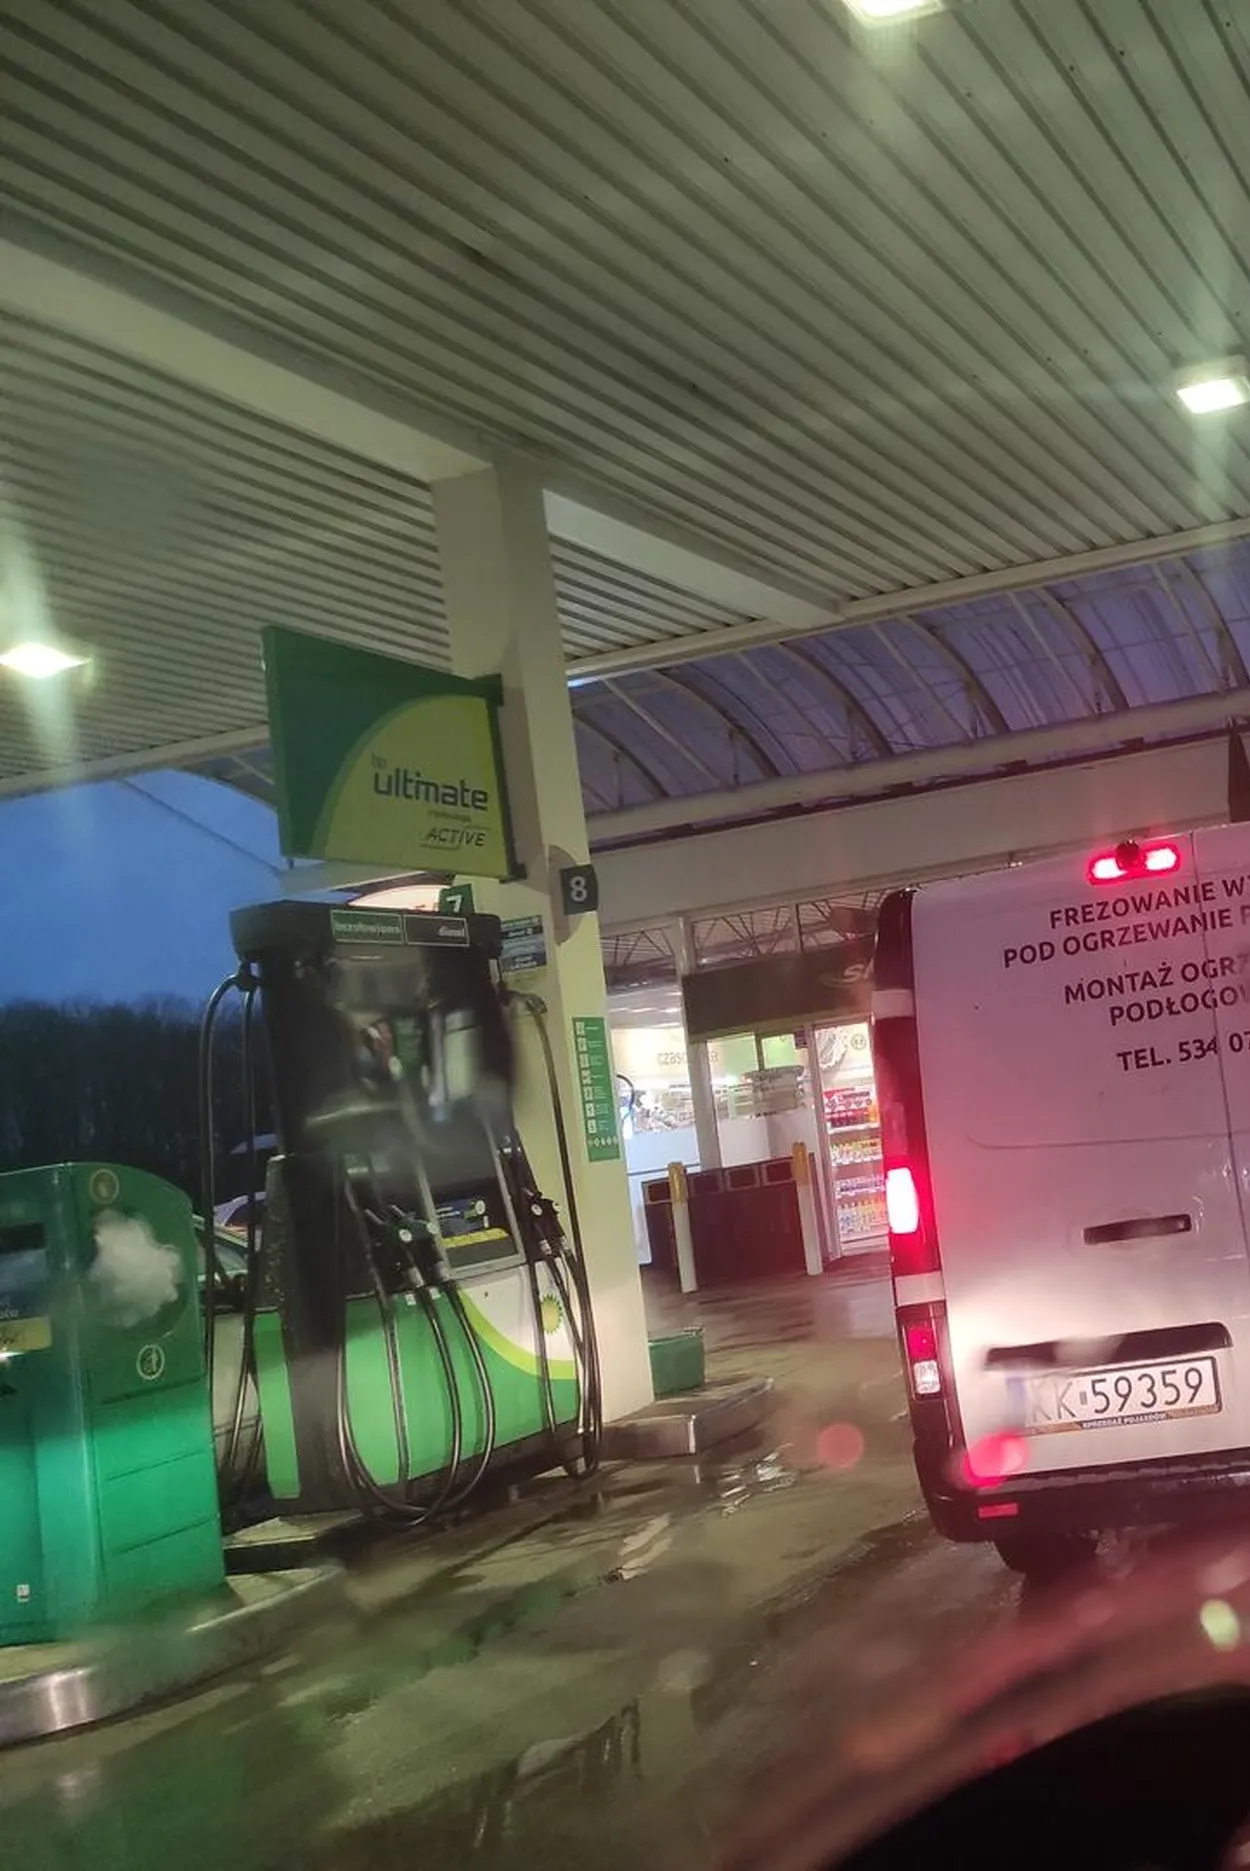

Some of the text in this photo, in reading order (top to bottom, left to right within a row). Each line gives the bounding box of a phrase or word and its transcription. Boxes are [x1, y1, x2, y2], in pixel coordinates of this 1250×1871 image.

[373, 767, 489, 812] ultimate
[427, 826, 487, 847] ACTIVE
[445, 894, 463, 913] 7
[570, 876, 589, 902] 8
[1050, 880, 1217, 930] FREZOWANIE
[1003, 940, 1056, 969] POD
[1062, 907, 1234, 957] OGRZEWANIE
[1063, 960, 1175, 1006] MONTAŻ
[1116, 1046, 1172, 1072] TEL.
[1177, 1035, 1219, 1063] 534
[1090, 1367, 1203, 1415] 59359
